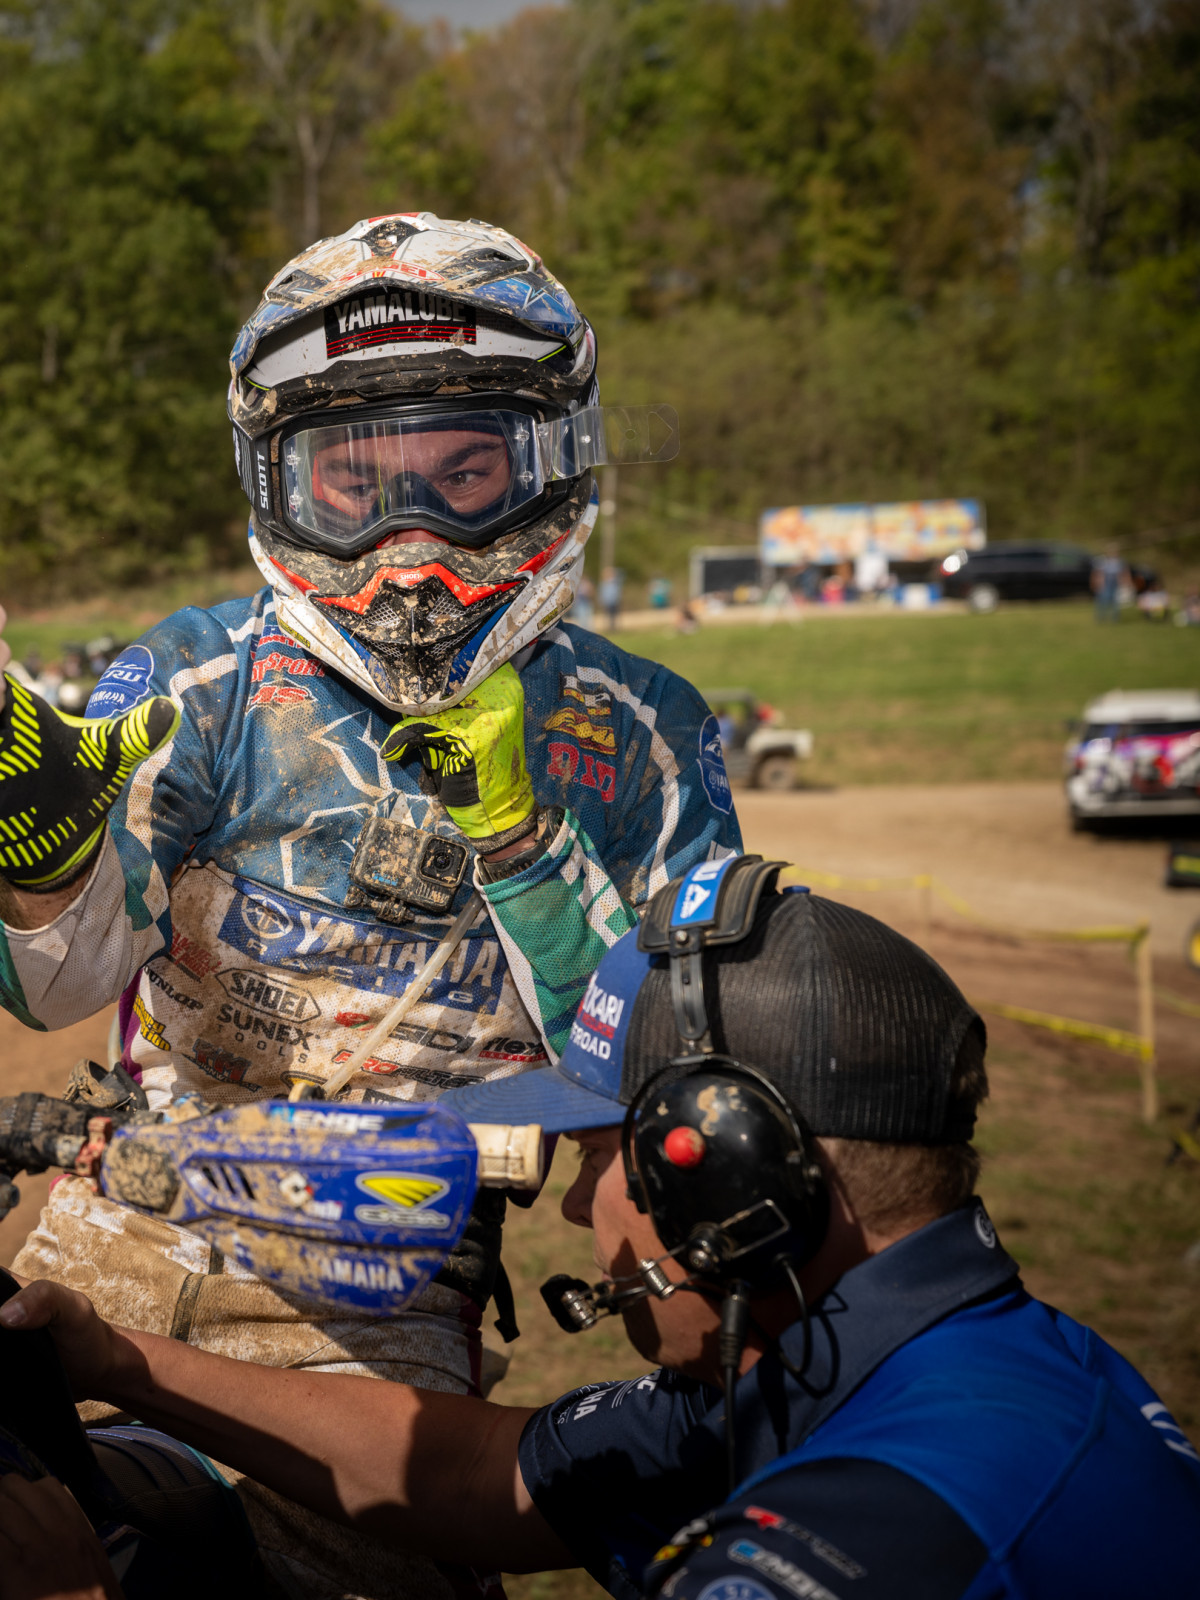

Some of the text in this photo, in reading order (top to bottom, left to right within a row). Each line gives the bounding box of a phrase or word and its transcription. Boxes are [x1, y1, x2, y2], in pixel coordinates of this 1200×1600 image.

[333, 291, 467, 335] YAMALUBE
[256, 450, 269, 511] SCOTT
[296, 911, 499, 987] YAMAHA
[230, 971, 308, 1020] SHOEI
[216, 1002, 314, 1052] SUNEX
[216, 1024, 308, 1064] TOOLS
[312, 1255, 404, 1292] AMAHA
